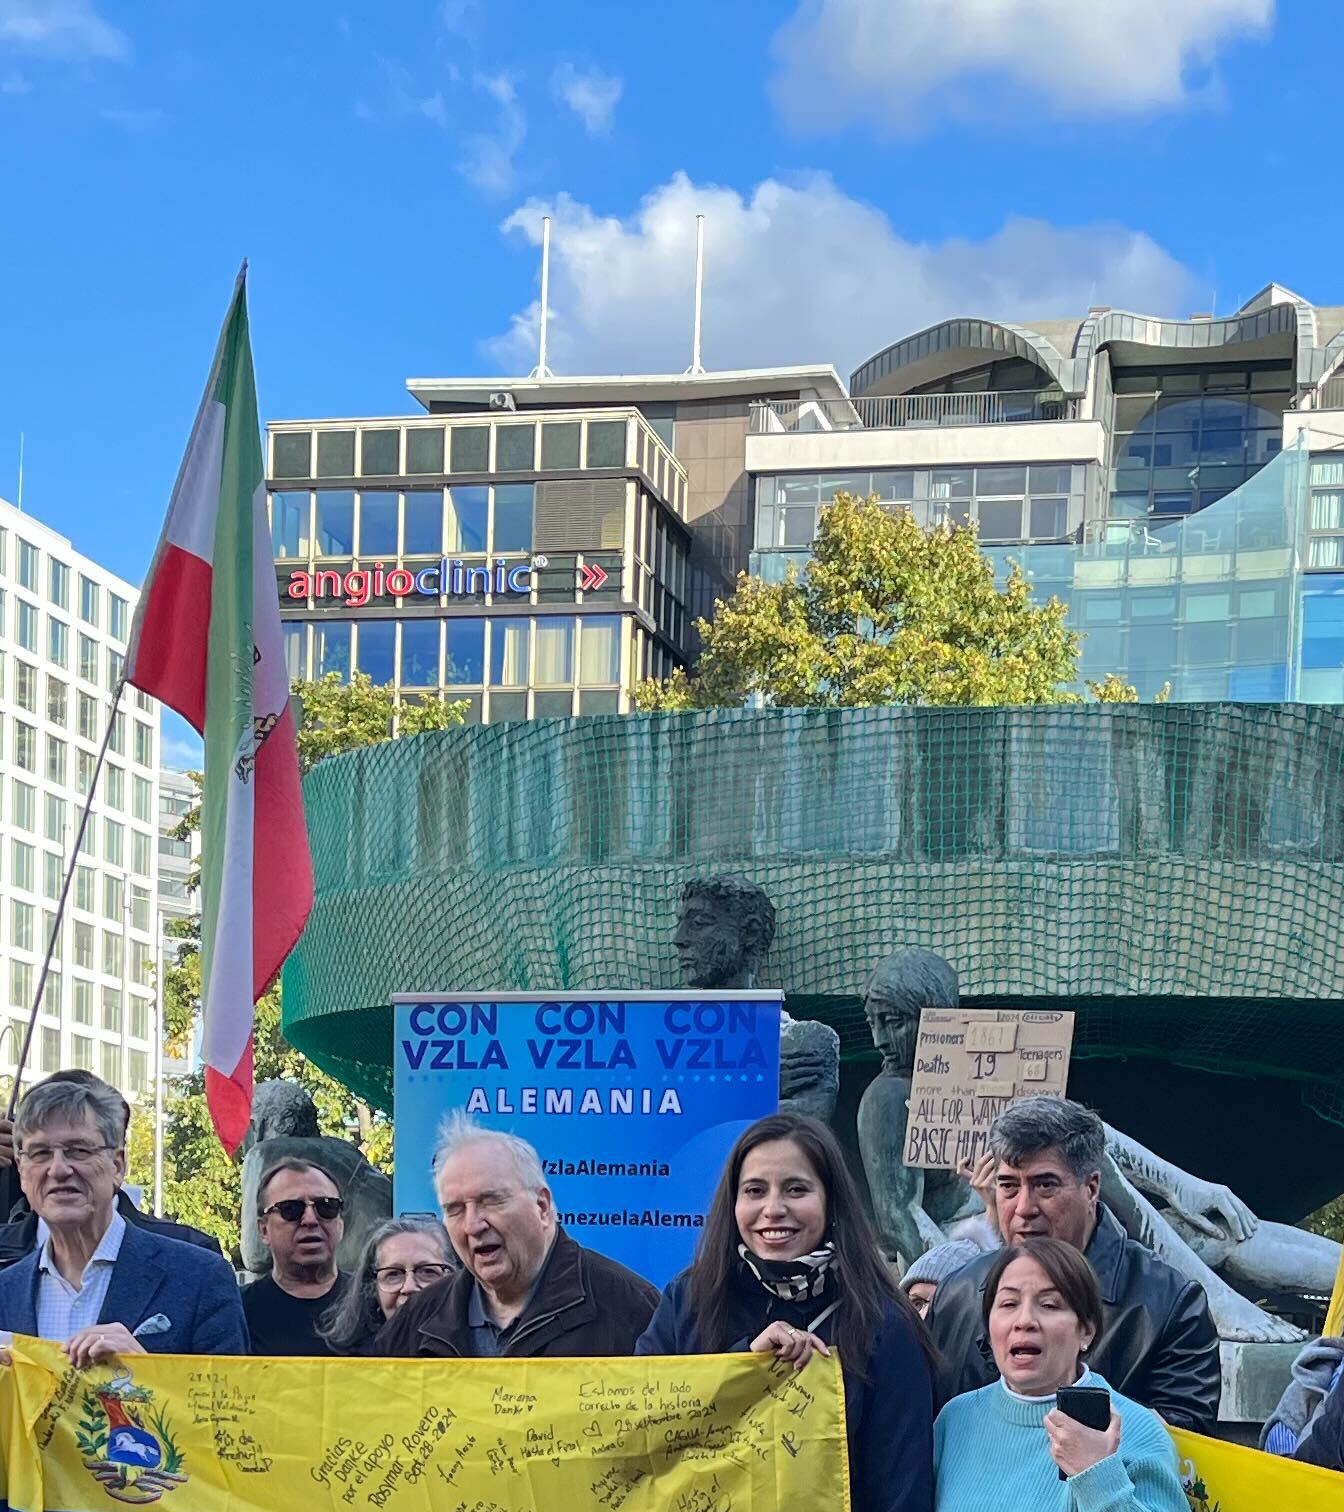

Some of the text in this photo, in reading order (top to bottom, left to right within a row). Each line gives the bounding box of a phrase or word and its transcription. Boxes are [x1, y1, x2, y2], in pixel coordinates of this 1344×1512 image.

[409, 1003, 755, 1036] CON CON CON
[402, 1039, 768, 1071] VZLA VZLA VZLA
[917, 1053, 997, 1080] Deaths 19
[466, 1086, 683, 1116] ALEMANIA
[916, 1086, 942, 1096] more
[915, 1098, 935, 1124] ALL
[941, 1098, 963, 1125] FOR
[908, 1126, 990, 1168] BASIC HUM
[557, 1210, 704, 1228] enezuelaAlema
[578, 1380, 692, 1398] Estamos del lado
[623, 1399, 639, 1411] de
[644, 1399, 653, 1411] la
[659, 1397, 702, 1412] historia
[401, 1406, 439, 1454] Rovero
[526, 1424, 554, 1442] David
[310, 1436, 353, 1490] Gracias
[341, 1433, 395, 1505] por el apoyo
